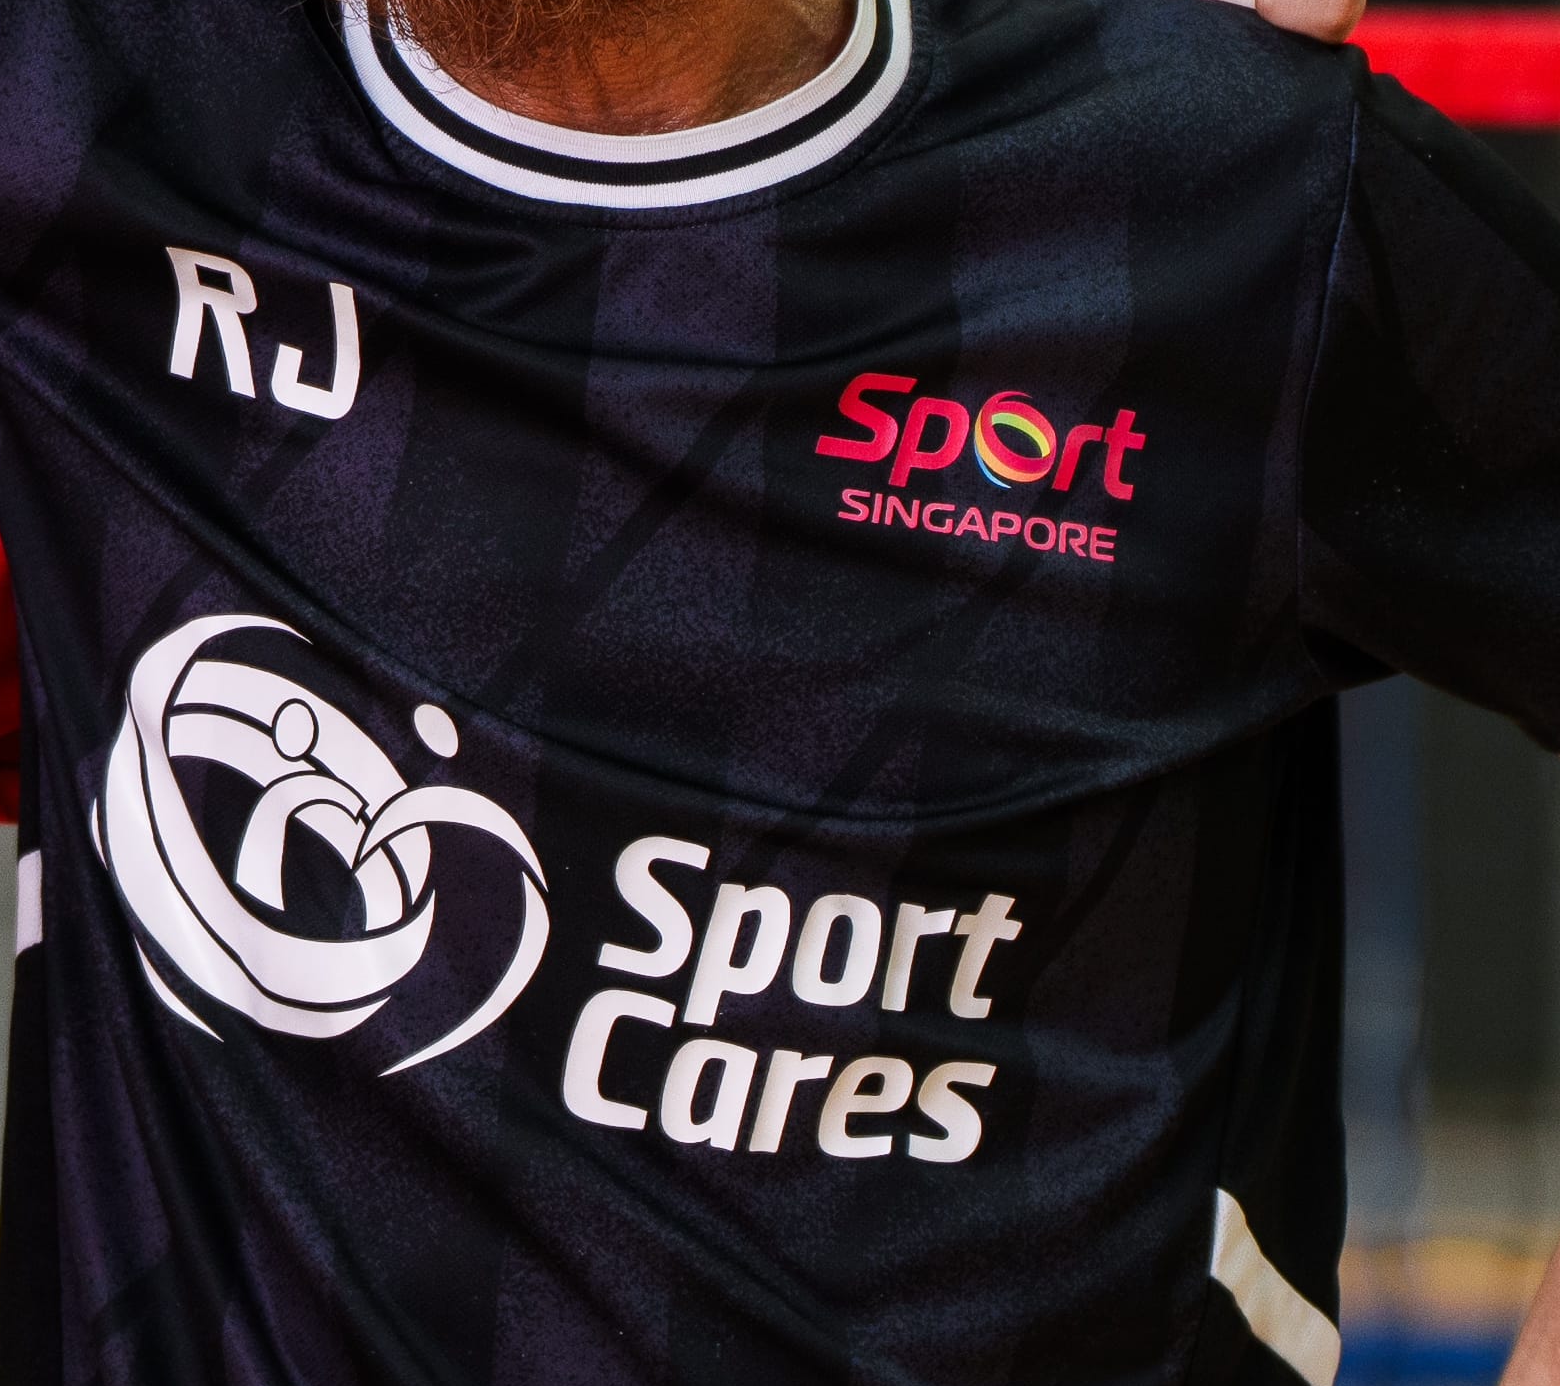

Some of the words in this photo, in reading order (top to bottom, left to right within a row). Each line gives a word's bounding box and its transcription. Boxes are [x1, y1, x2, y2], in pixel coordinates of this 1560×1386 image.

[165, 246, 361, 420] RJ
[814, 372, 1147, 501] Sport
[837, 487, 1118, 563] SINGAPORE
[597, 835, 1023, 1027] Sport
[562, 989, 997, 1163] Cares
